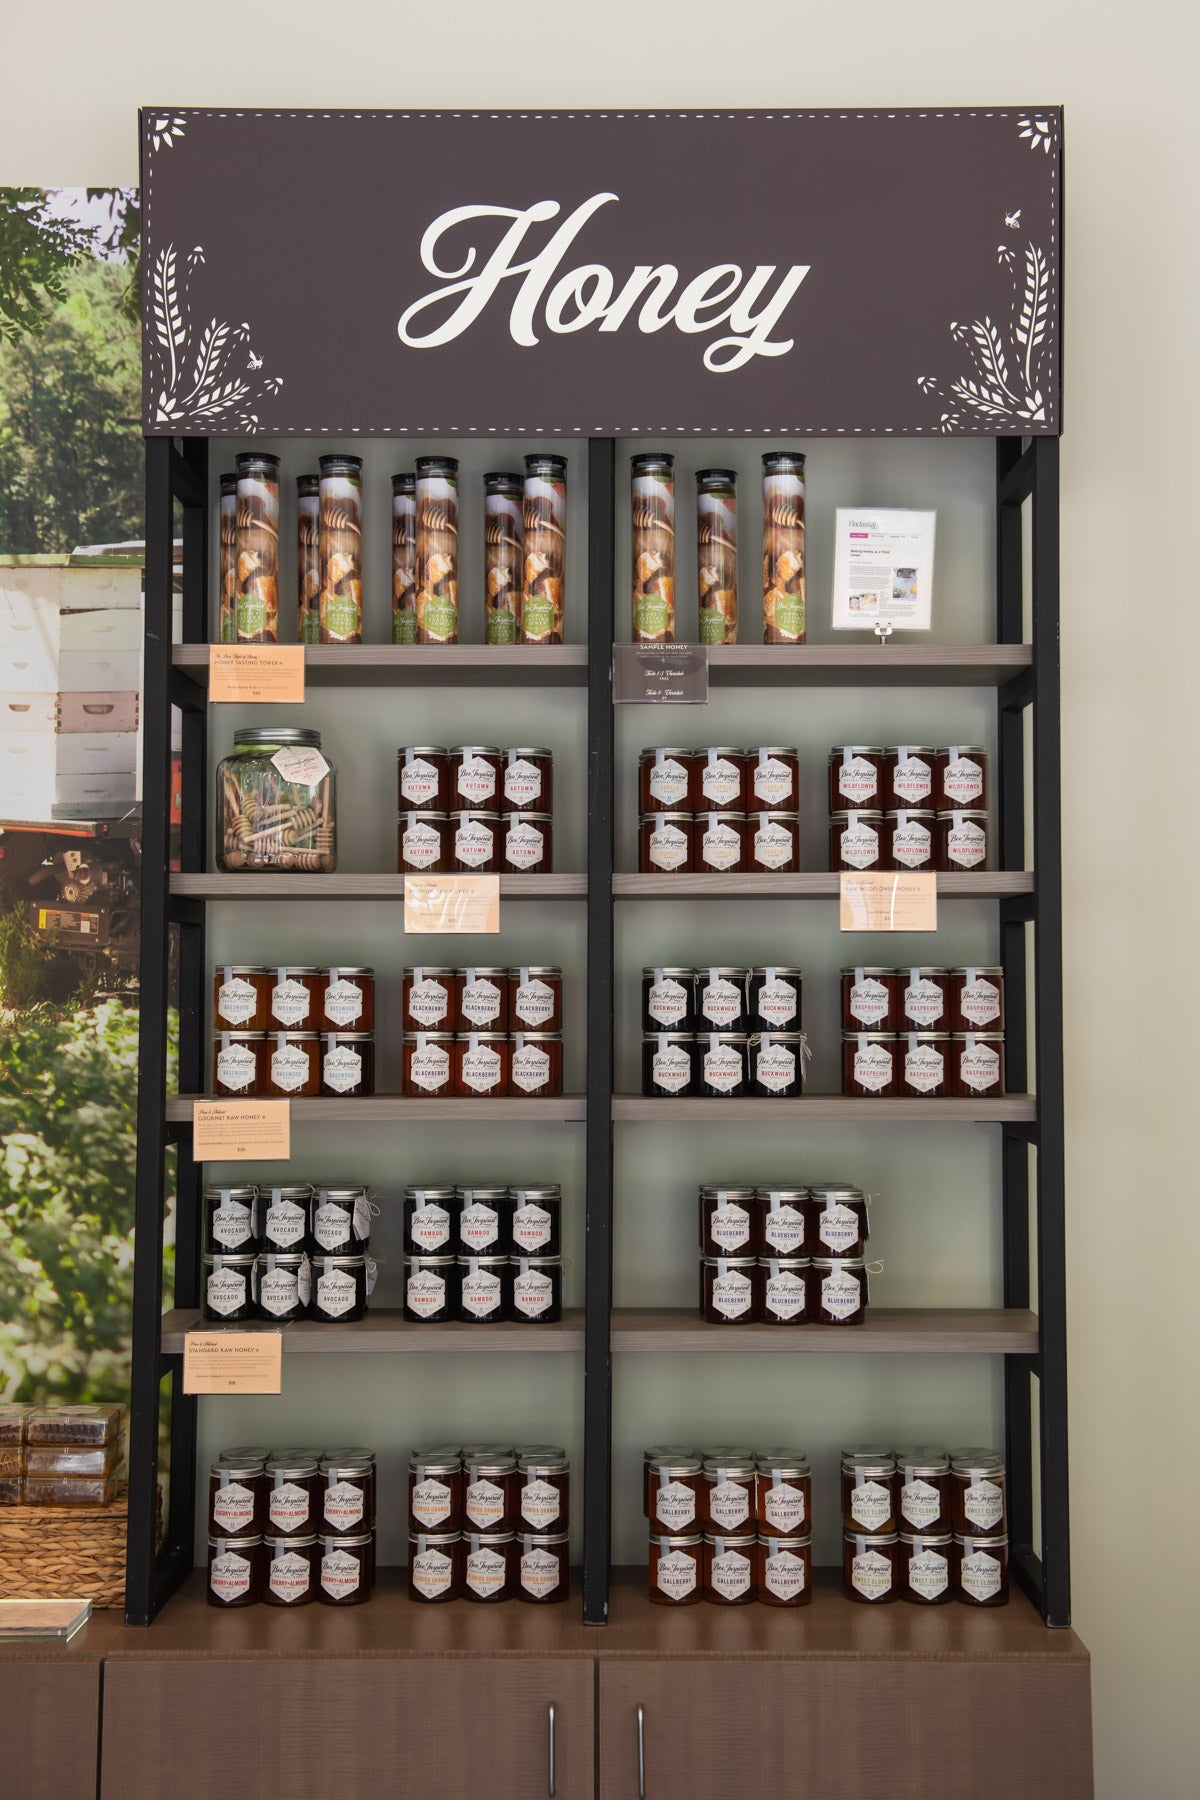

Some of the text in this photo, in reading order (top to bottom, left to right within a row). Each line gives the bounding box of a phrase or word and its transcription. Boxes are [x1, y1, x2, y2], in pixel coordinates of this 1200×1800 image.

[398, 192, 811, 373] Honey
[412, 771, 437, 780] Inspired
[470, 770, 494, 779] Inspired
[662, 772, 687, 781] Inspired
[714, 771, 739, 780] Inspired
[851, 769, 876, 778] Inspired
[906, 770, 930, 779] Inspired
[467, 834, 492, 843] Inspired
[714, 837, 739, 846] Inspired
[905, 834, 930, 843] Inspired
[230, 991, 255, 1000] Inspired
[283, 992, 308, 1001] Inspired
[421, 992, 446, 1001] Inspired
[661, 992, 685, 1001] Inspired
[862, 991, 886, 1000] Inspired
[282, 1057, 307, 1066] Inspired
[474, 1058, 499, 1067] Inspired
[716, 1057, 741, 1066] Inspired
[916, 1058, 941, 1067] Inspired
[226, 1214, 250, 1223] Inspired
[424, 1217, 448, 1226] Inspired
[722, 1216, 747, 1226] Inspired
[272, 1281, 297, 1290] Inspired
[474, 1282, 499, 1291] Inspired
[778, 1284, 803, 1293] Inspired
[218, 1496, 252, 1506] Bee Inspired
[415, 1492, 448, 1502] Bee Inspired
[660, 1495, 693, 1504] Bee Inspired
[854, 1495, 888, 1504] Bee Inspired
[273, 1566, 307, 1575] Bee Inspired
[469, 1561, 503, 1571] Bee Inspired
[715, 1564, 749, 1574] Bee Inspired
[912, 1563, 946, 1573] Bee Inspired
